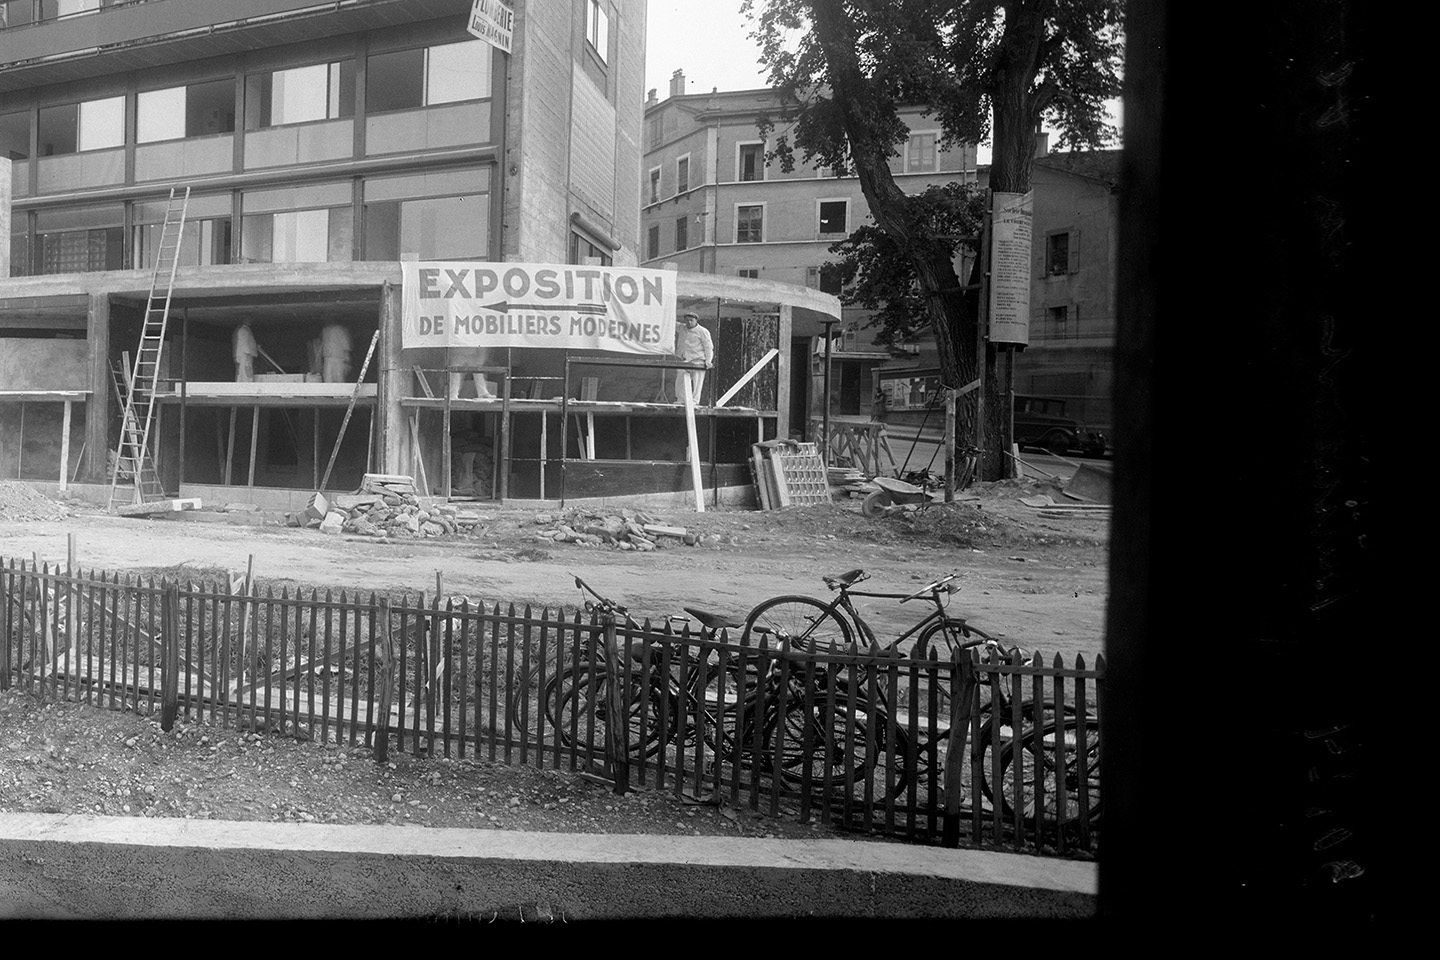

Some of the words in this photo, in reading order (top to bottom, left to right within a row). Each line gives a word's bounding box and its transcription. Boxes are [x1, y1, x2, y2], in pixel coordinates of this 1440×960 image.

[418, 267, 663, 306] EXPOSITION
[419, 315, 444, 335] DE
[454, 314, 561, 336] MOBILIERS
[569, 318, 661, 344] MODERNES
